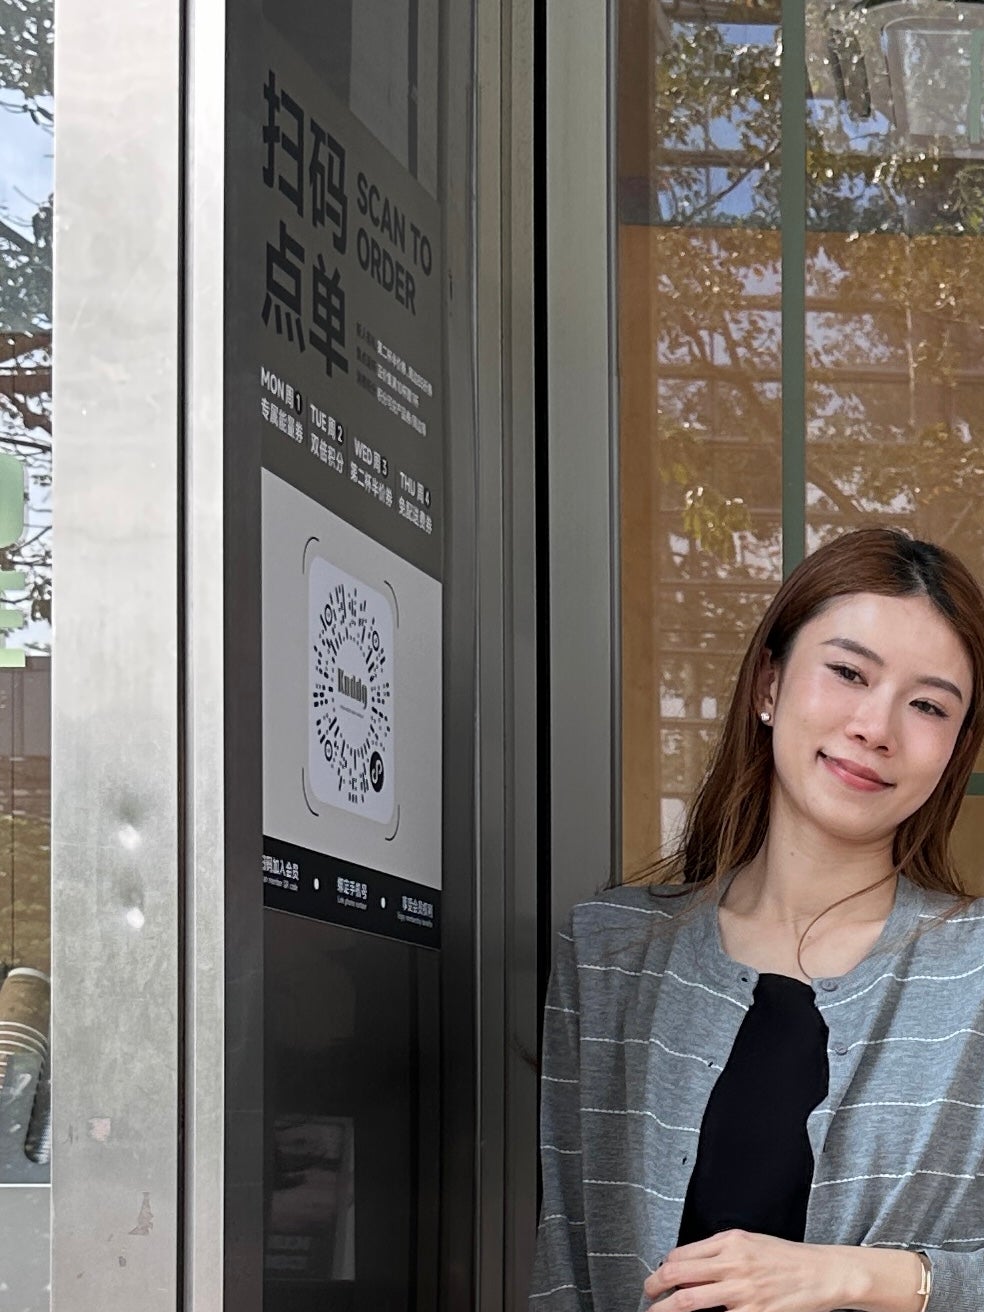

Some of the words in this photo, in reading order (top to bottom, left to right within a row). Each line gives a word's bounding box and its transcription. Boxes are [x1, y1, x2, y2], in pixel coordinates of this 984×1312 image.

[261, 68, 350, 256] 扫码
[355, 171, 406, 254] SCAN
[409, 222, 433, 277] TO
[260, 219, 350, 379] 点单
[355, 227, 417, 317] ORDER
[260, 365, 285, 402] MON
[309, 402, 327, 433] TUE
[353, 436, 373, 466] WED
[399, 470, 416, 497] THU
